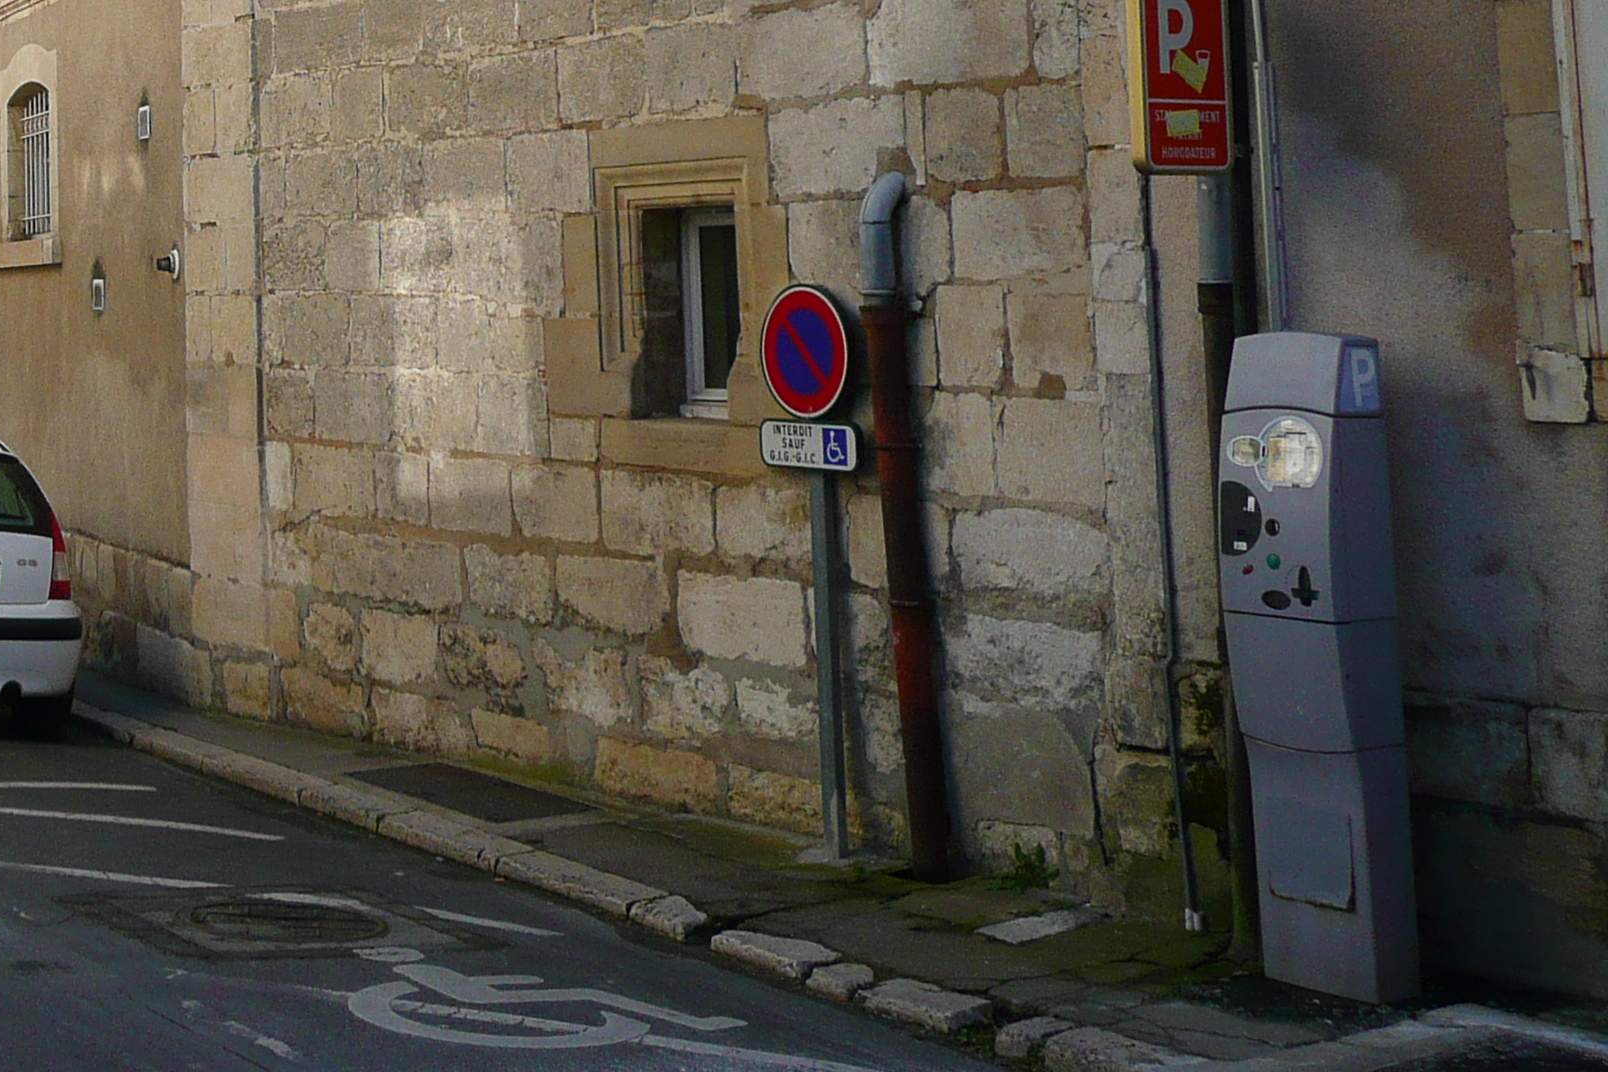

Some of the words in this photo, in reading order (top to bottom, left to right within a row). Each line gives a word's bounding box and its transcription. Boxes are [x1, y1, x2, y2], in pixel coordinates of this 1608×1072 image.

[1161, 146, 1216, 159] HORODATEUR
[1351, 348, 1375, 406] P
[773, 424, 812, 437] INTERDIT
[781, 438, 806, 450] SAUF
